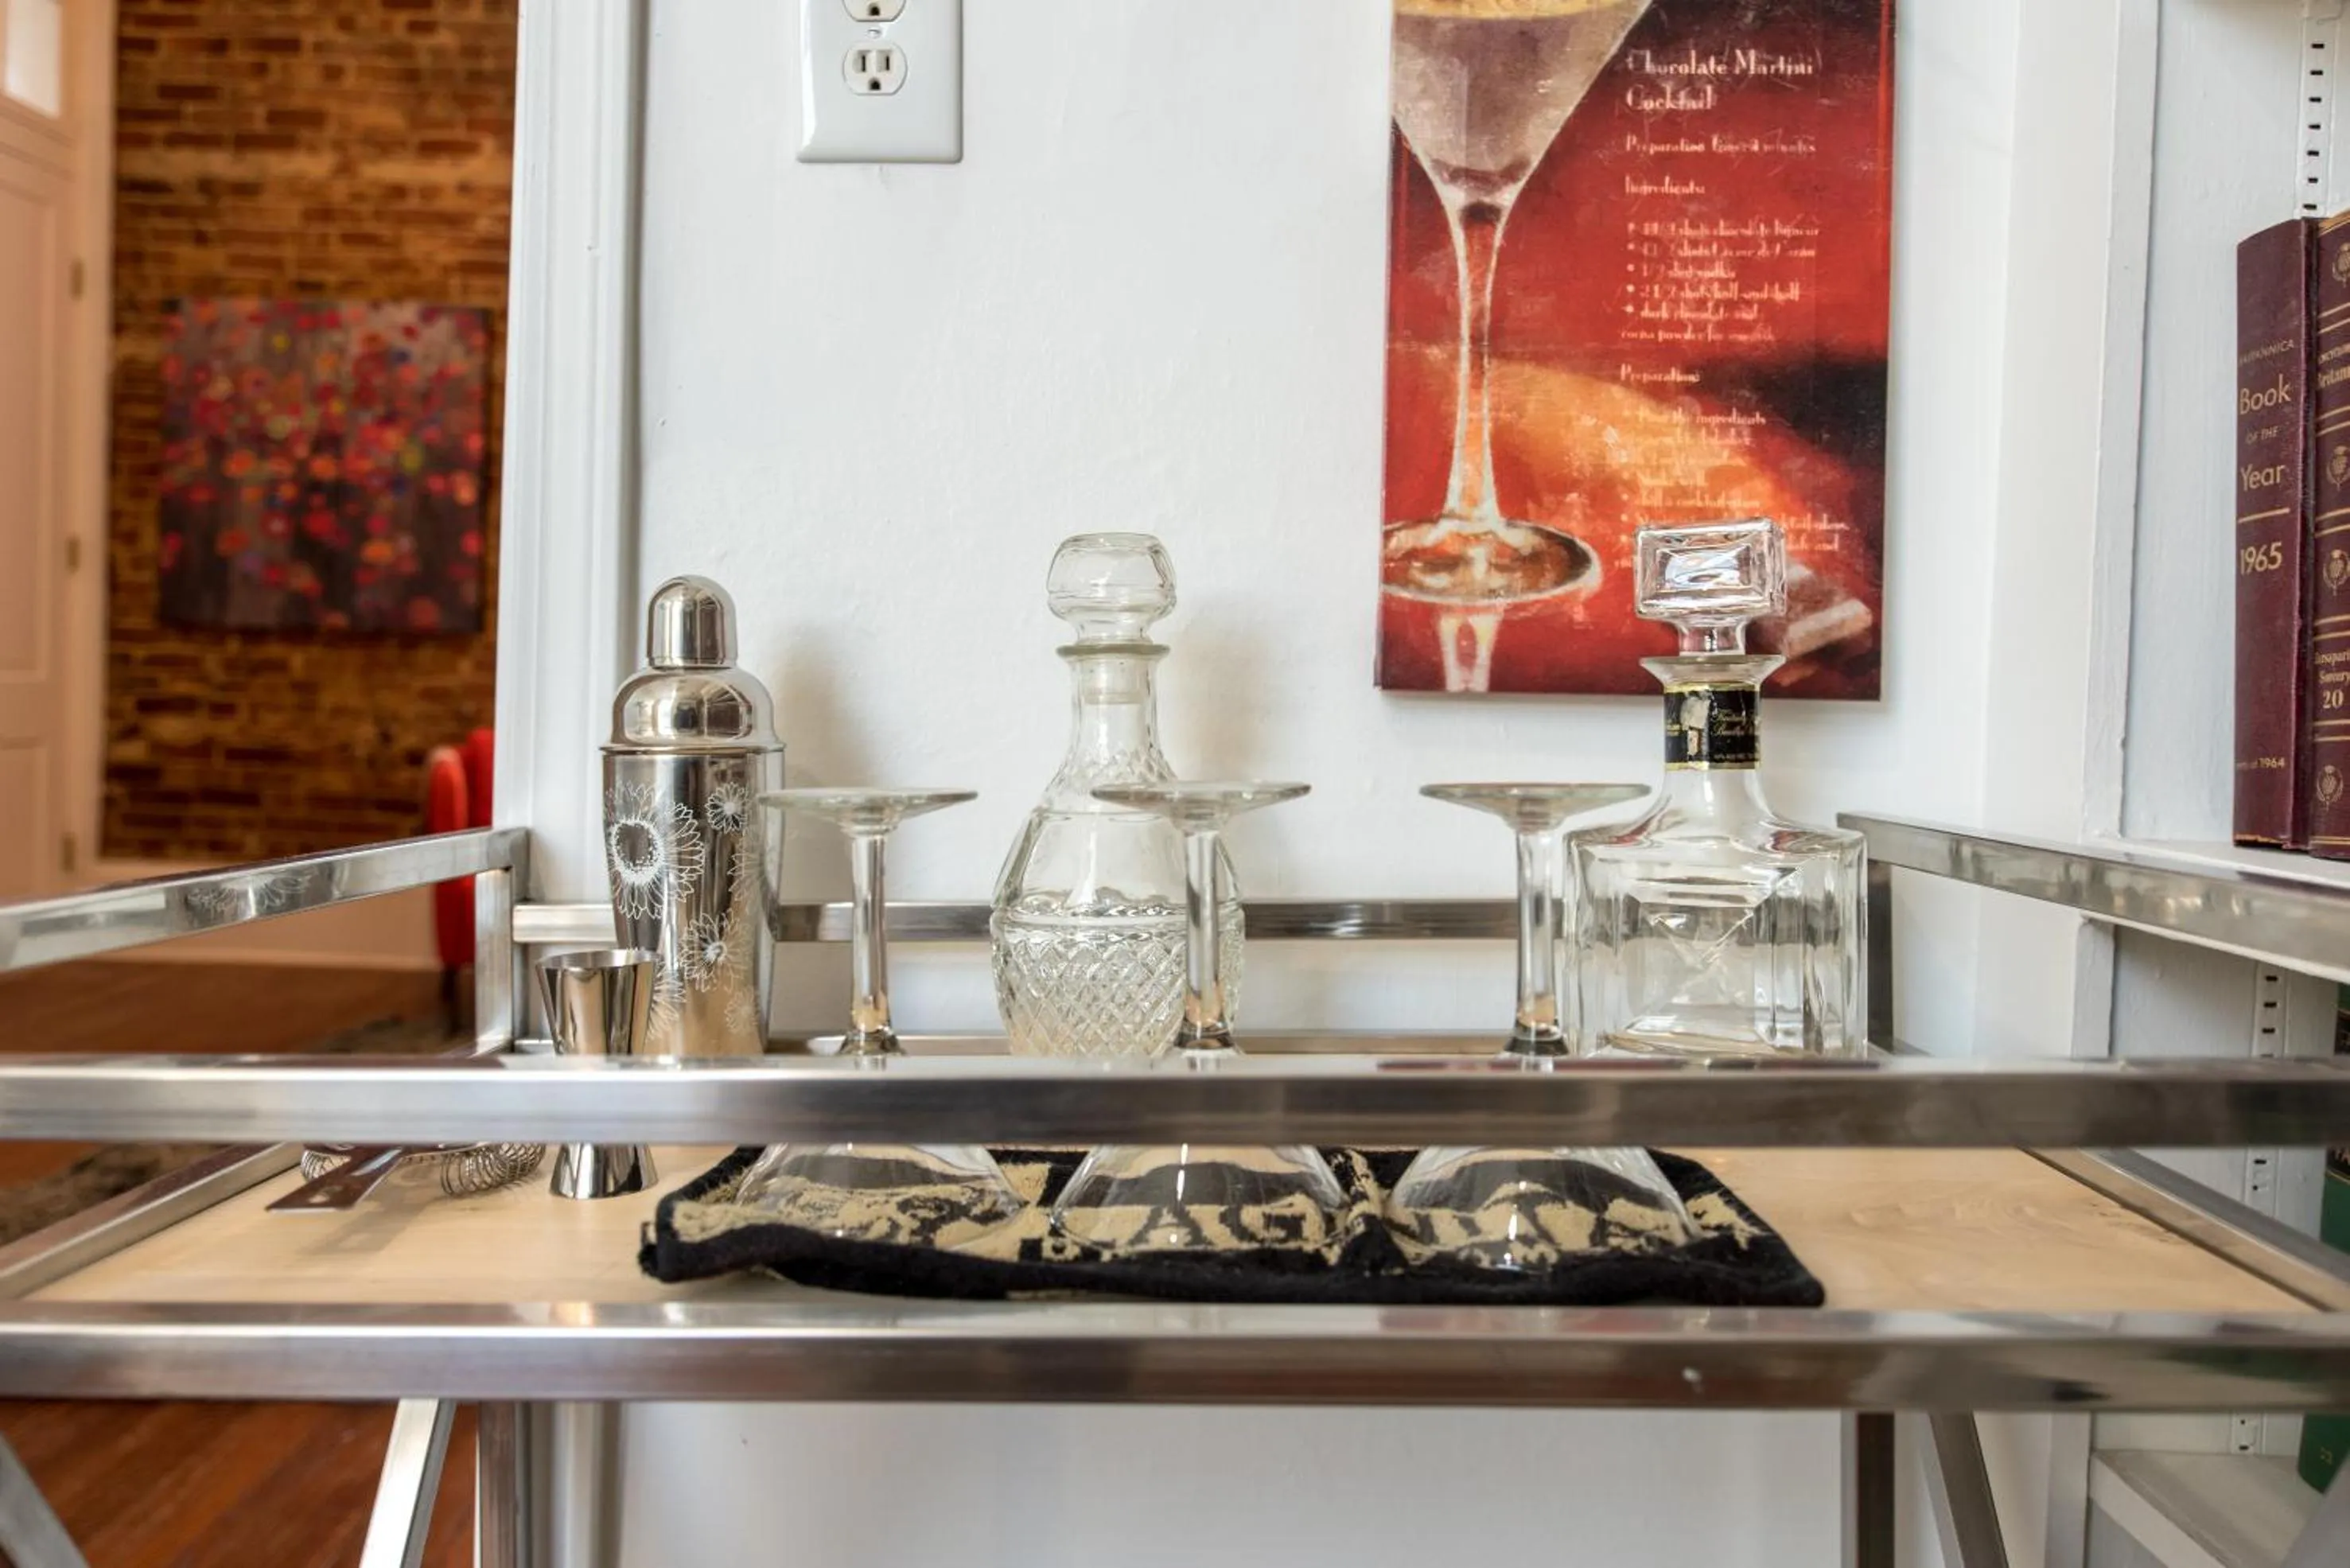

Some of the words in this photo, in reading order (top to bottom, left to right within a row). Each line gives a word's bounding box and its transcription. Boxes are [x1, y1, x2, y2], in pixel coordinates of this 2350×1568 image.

[1626, 49, 1728, 75] Chocolate
[1734, 49, 1813, 76] Martini
[1625, 84, 1713, 110] Cocktail
[2239, 373, 2291, 414] Book
[2240, 464, 2286, 492] Year
[2240, 541, 2282, 575] 1965
[2322, 689, 2344, 709] 20
